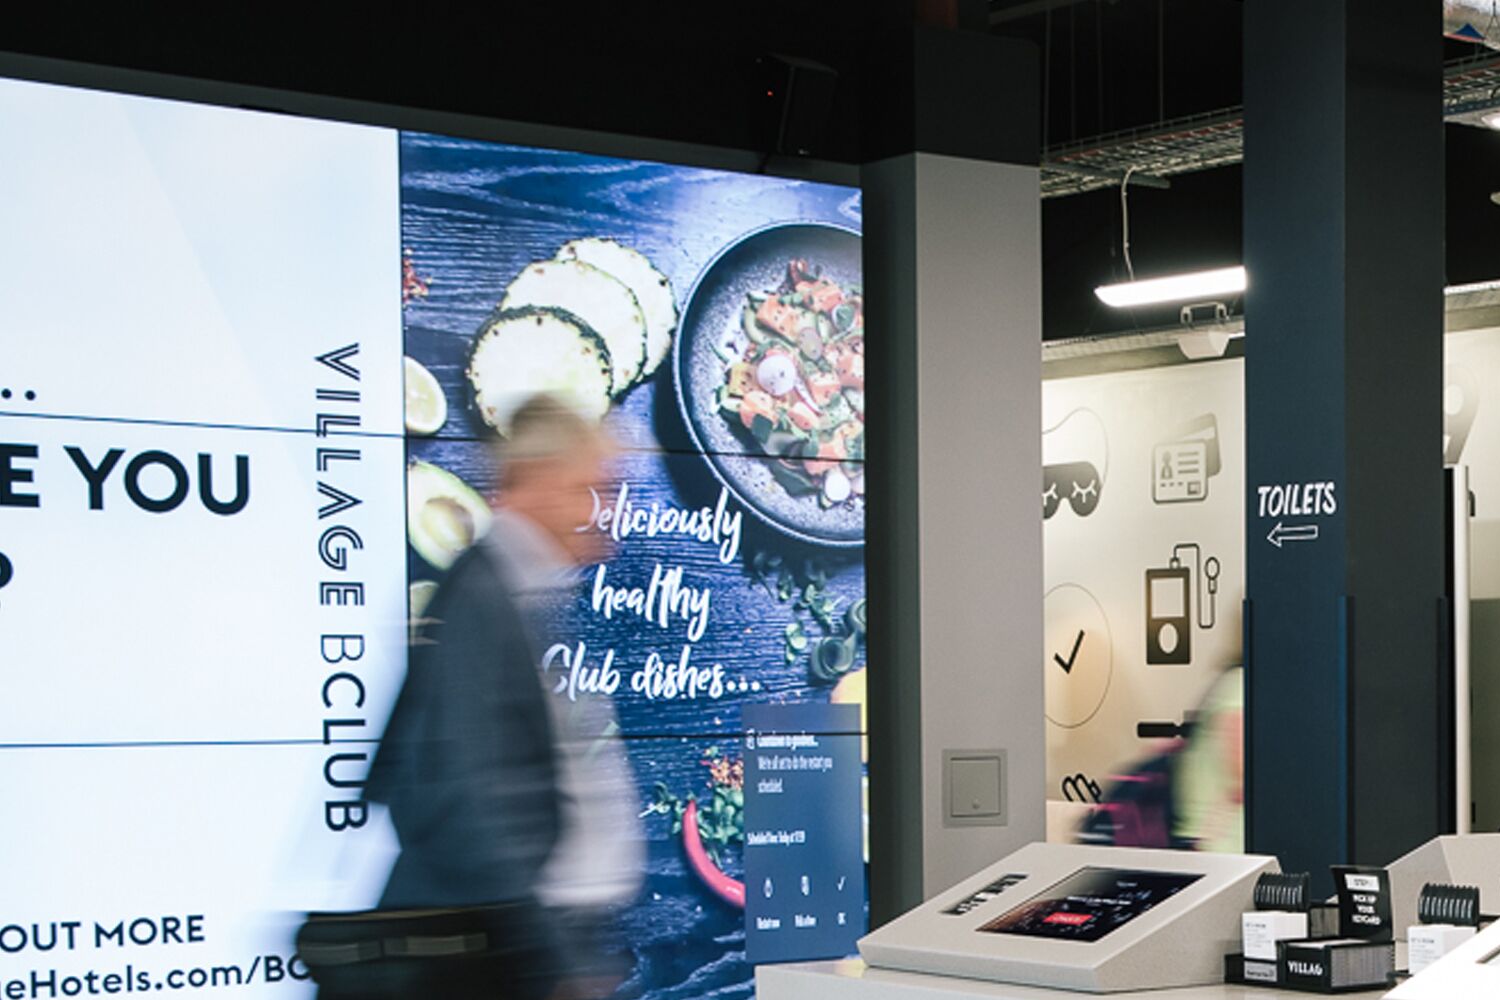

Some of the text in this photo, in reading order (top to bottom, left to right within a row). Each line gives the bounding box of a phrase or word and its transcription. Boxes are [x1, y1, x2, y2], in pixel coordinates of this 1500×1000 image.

[62, 445, 250, 516] YOU
[315, 343, 364, 606] VILLAGE
[1257, 481, 1337, 517] TOILETS
[592, 563, 710, 642] healthy
[542, 641, 761, 702] Club dishes...
[0, 914, 205, 953] OUT MORE
